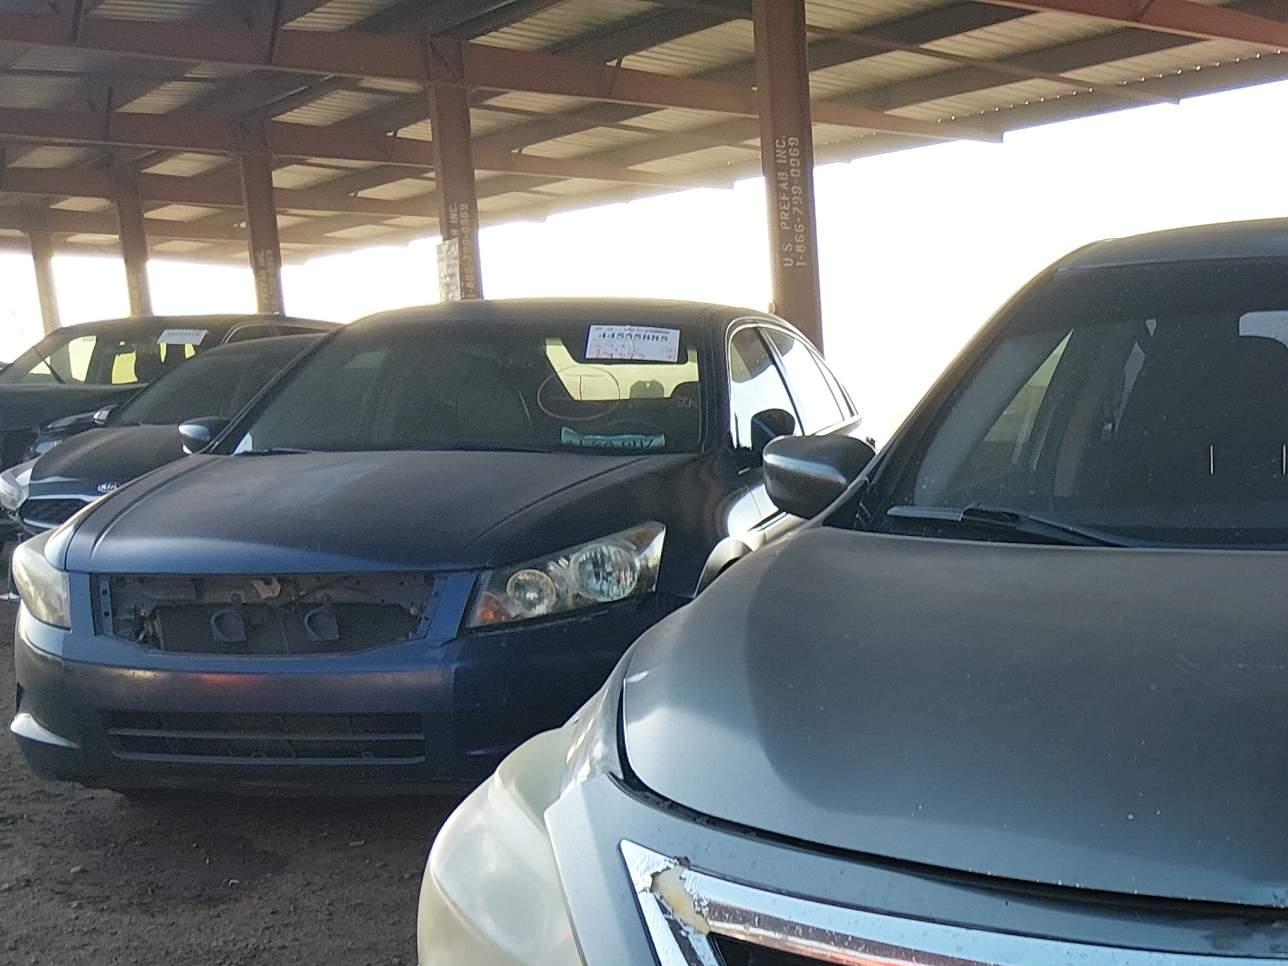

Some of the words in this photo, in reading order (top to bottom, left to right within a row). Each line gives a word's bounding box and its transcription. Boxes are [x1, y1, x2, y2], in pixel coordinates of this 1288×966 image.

[775, 135, 787, 164] INC.
[777, 169, 791, 231] PREFAB
[788, 136, 808, 267] 1-866-799-0969
